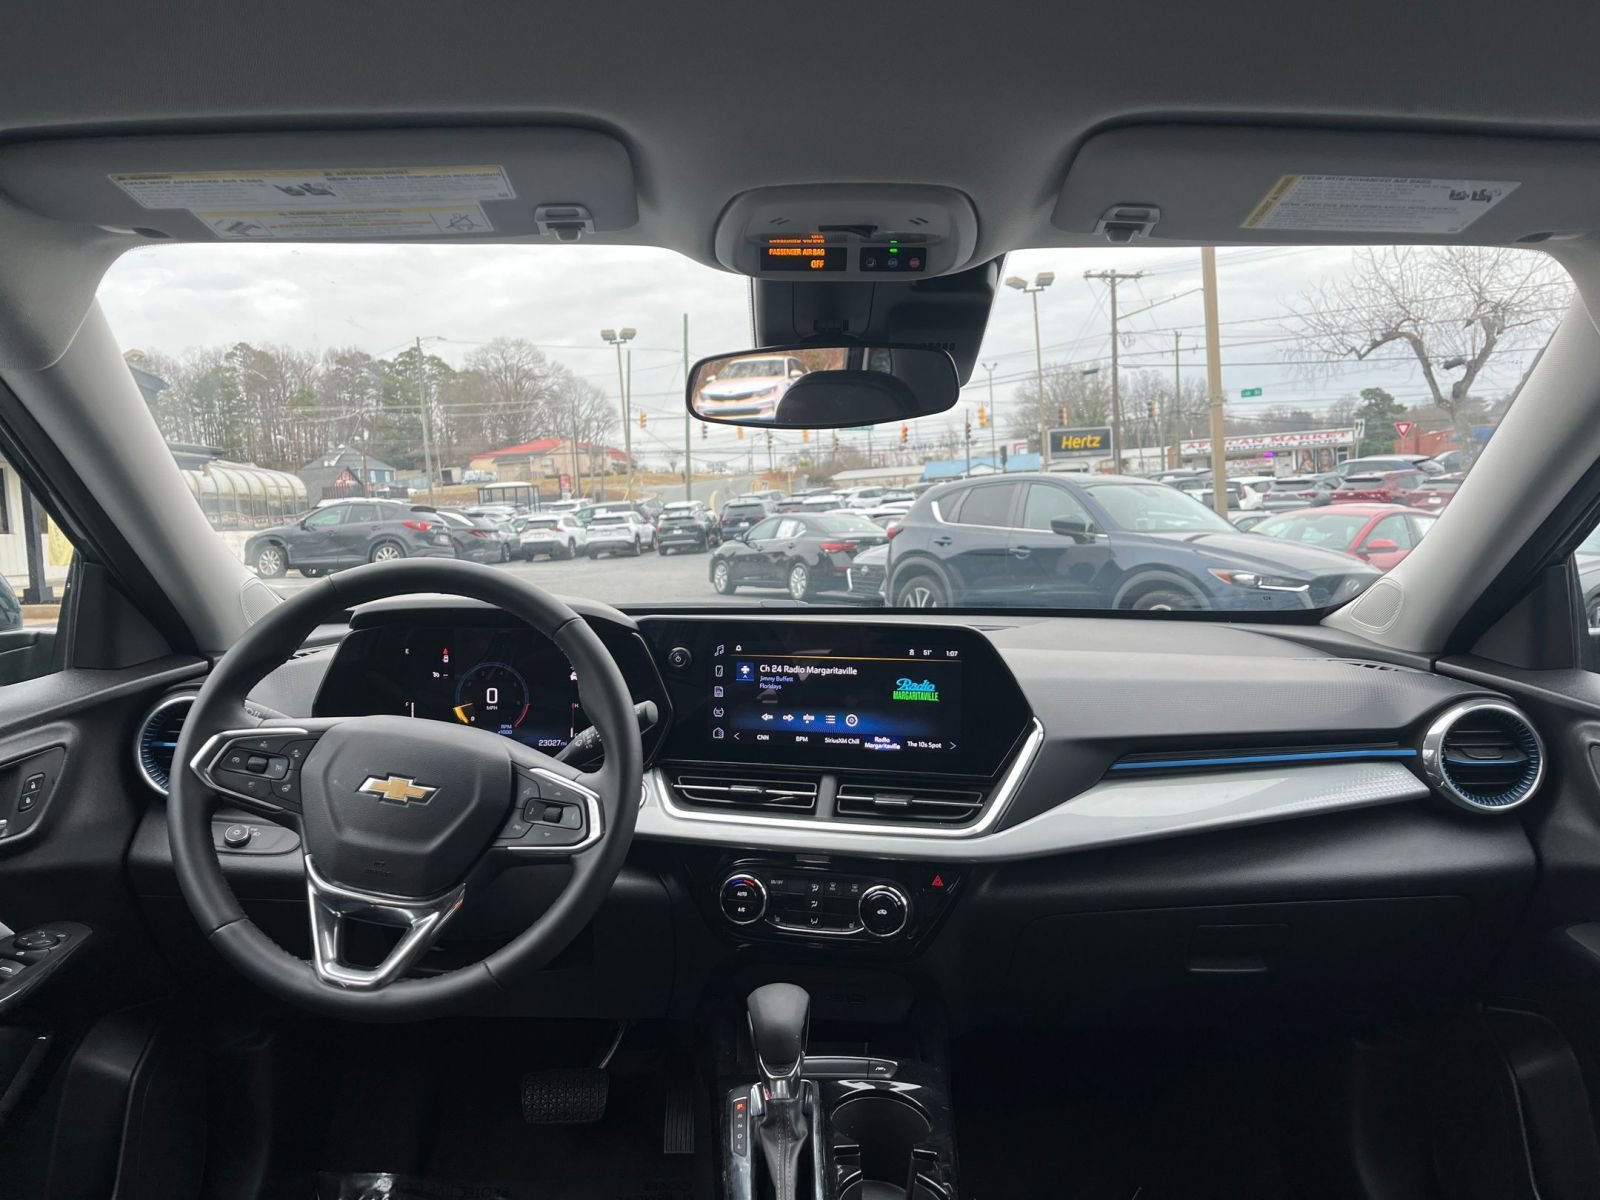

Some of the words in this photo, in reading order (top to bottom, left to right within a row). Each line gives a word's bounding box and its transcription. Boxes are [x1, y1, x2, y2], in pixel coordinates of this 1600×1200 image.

[769, 248, 801, 256] PASSENGER
[811, 259, 824, 268] OFF
[1061, 434, 1101, 449] Hertz
[1271, 431, 1348, 443] MARKET
[760, 664, 770, 673] Ch
[771, 665, 782, 673] 24
[783, 665, 805, 674] Radio
[806, 666, 858, 676] Margaritaville
[896, 678, 936, 691] Radio
[486, 687, 498, 704] 0
[893, 690, 940, 701] MARGARITAVILLE
[538, 739, 561, 747] 23027
[864, 742, 901, 750] Margaritaville
